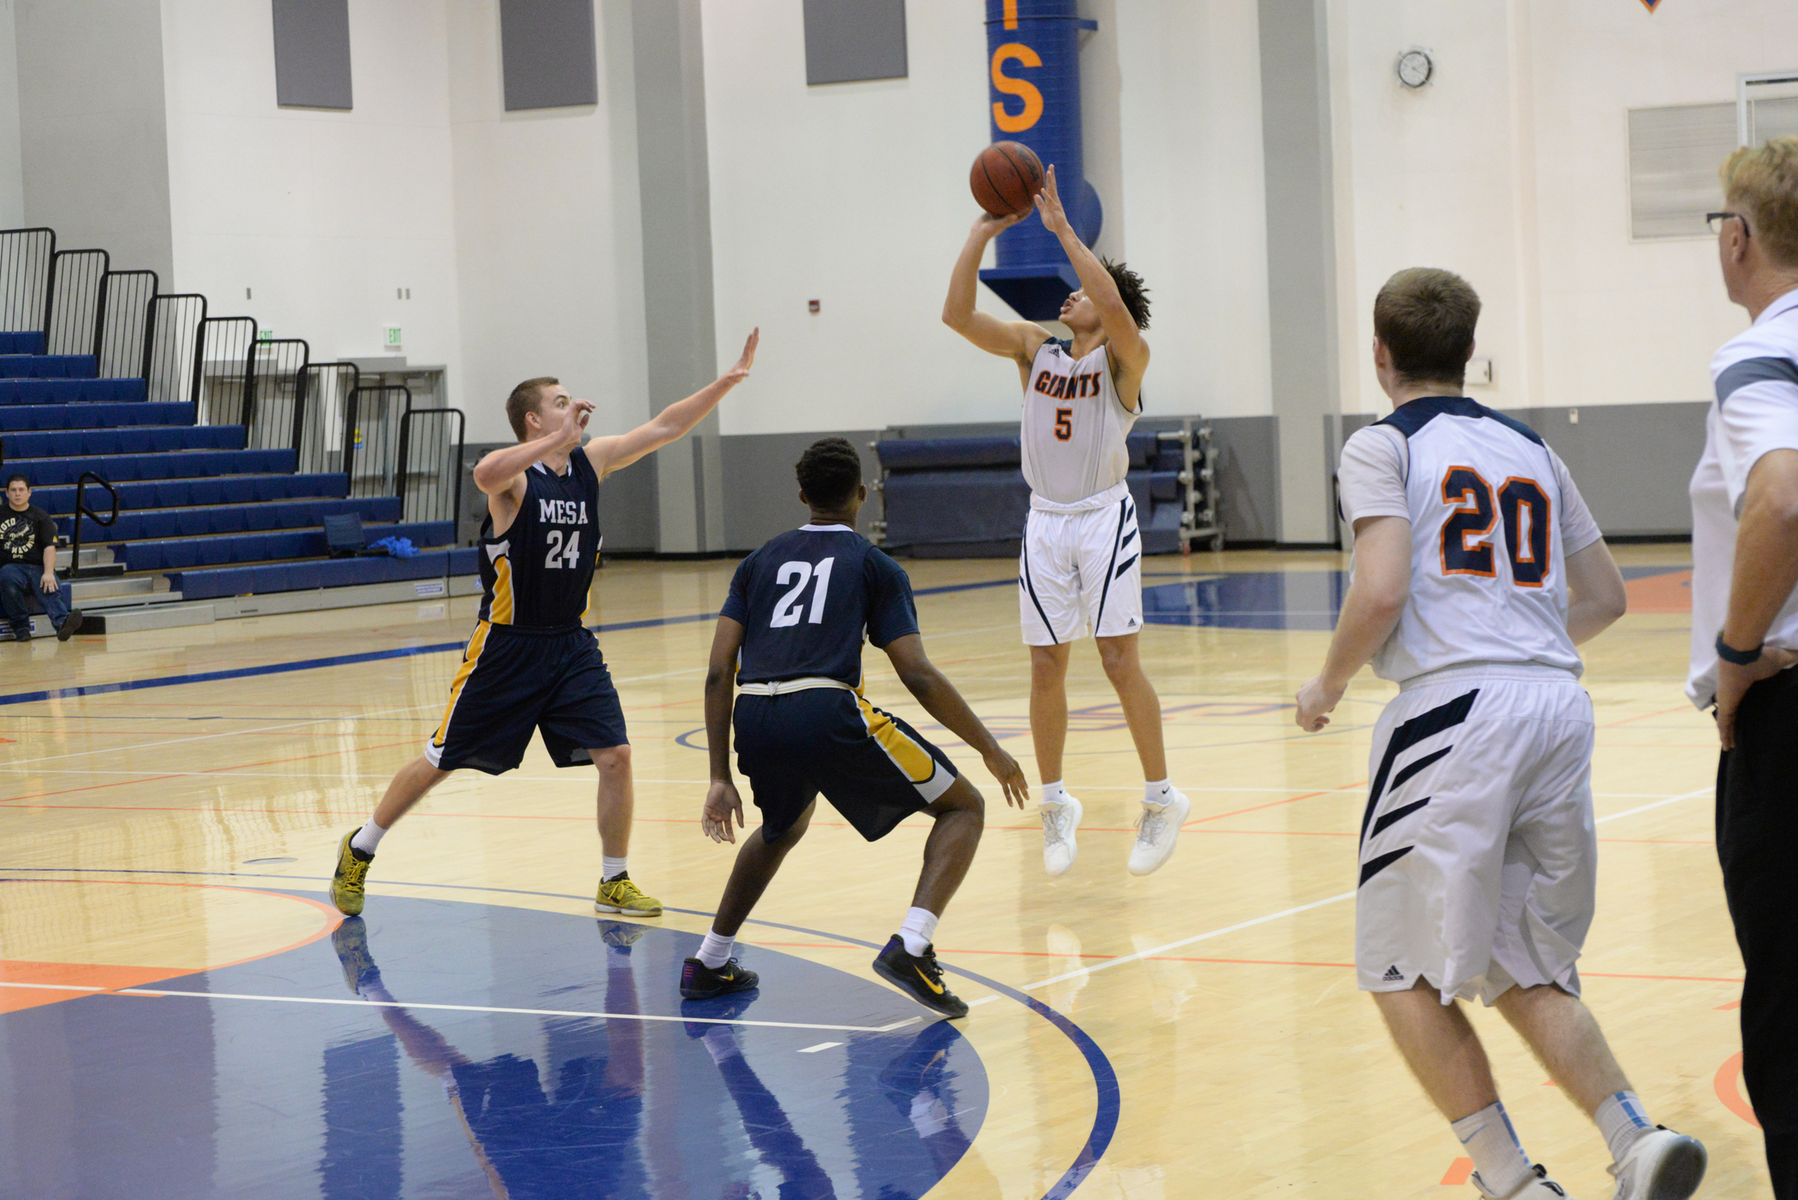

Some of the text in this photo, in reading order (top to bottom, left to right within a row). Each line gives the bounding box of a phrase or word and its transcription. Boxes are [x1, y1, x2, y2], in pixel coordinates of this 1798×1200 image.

[389, 328, 401, 343] EXIT
[1034, 369, 1104, 401] GIANTS
[1054, 407, 1073, 442] 5
[539, 498, 588, 525] MESA
[1440, 465, 1552, 588] 20
[544, 529, 580, 569] 24
[769, 556, 835, 628] 21
